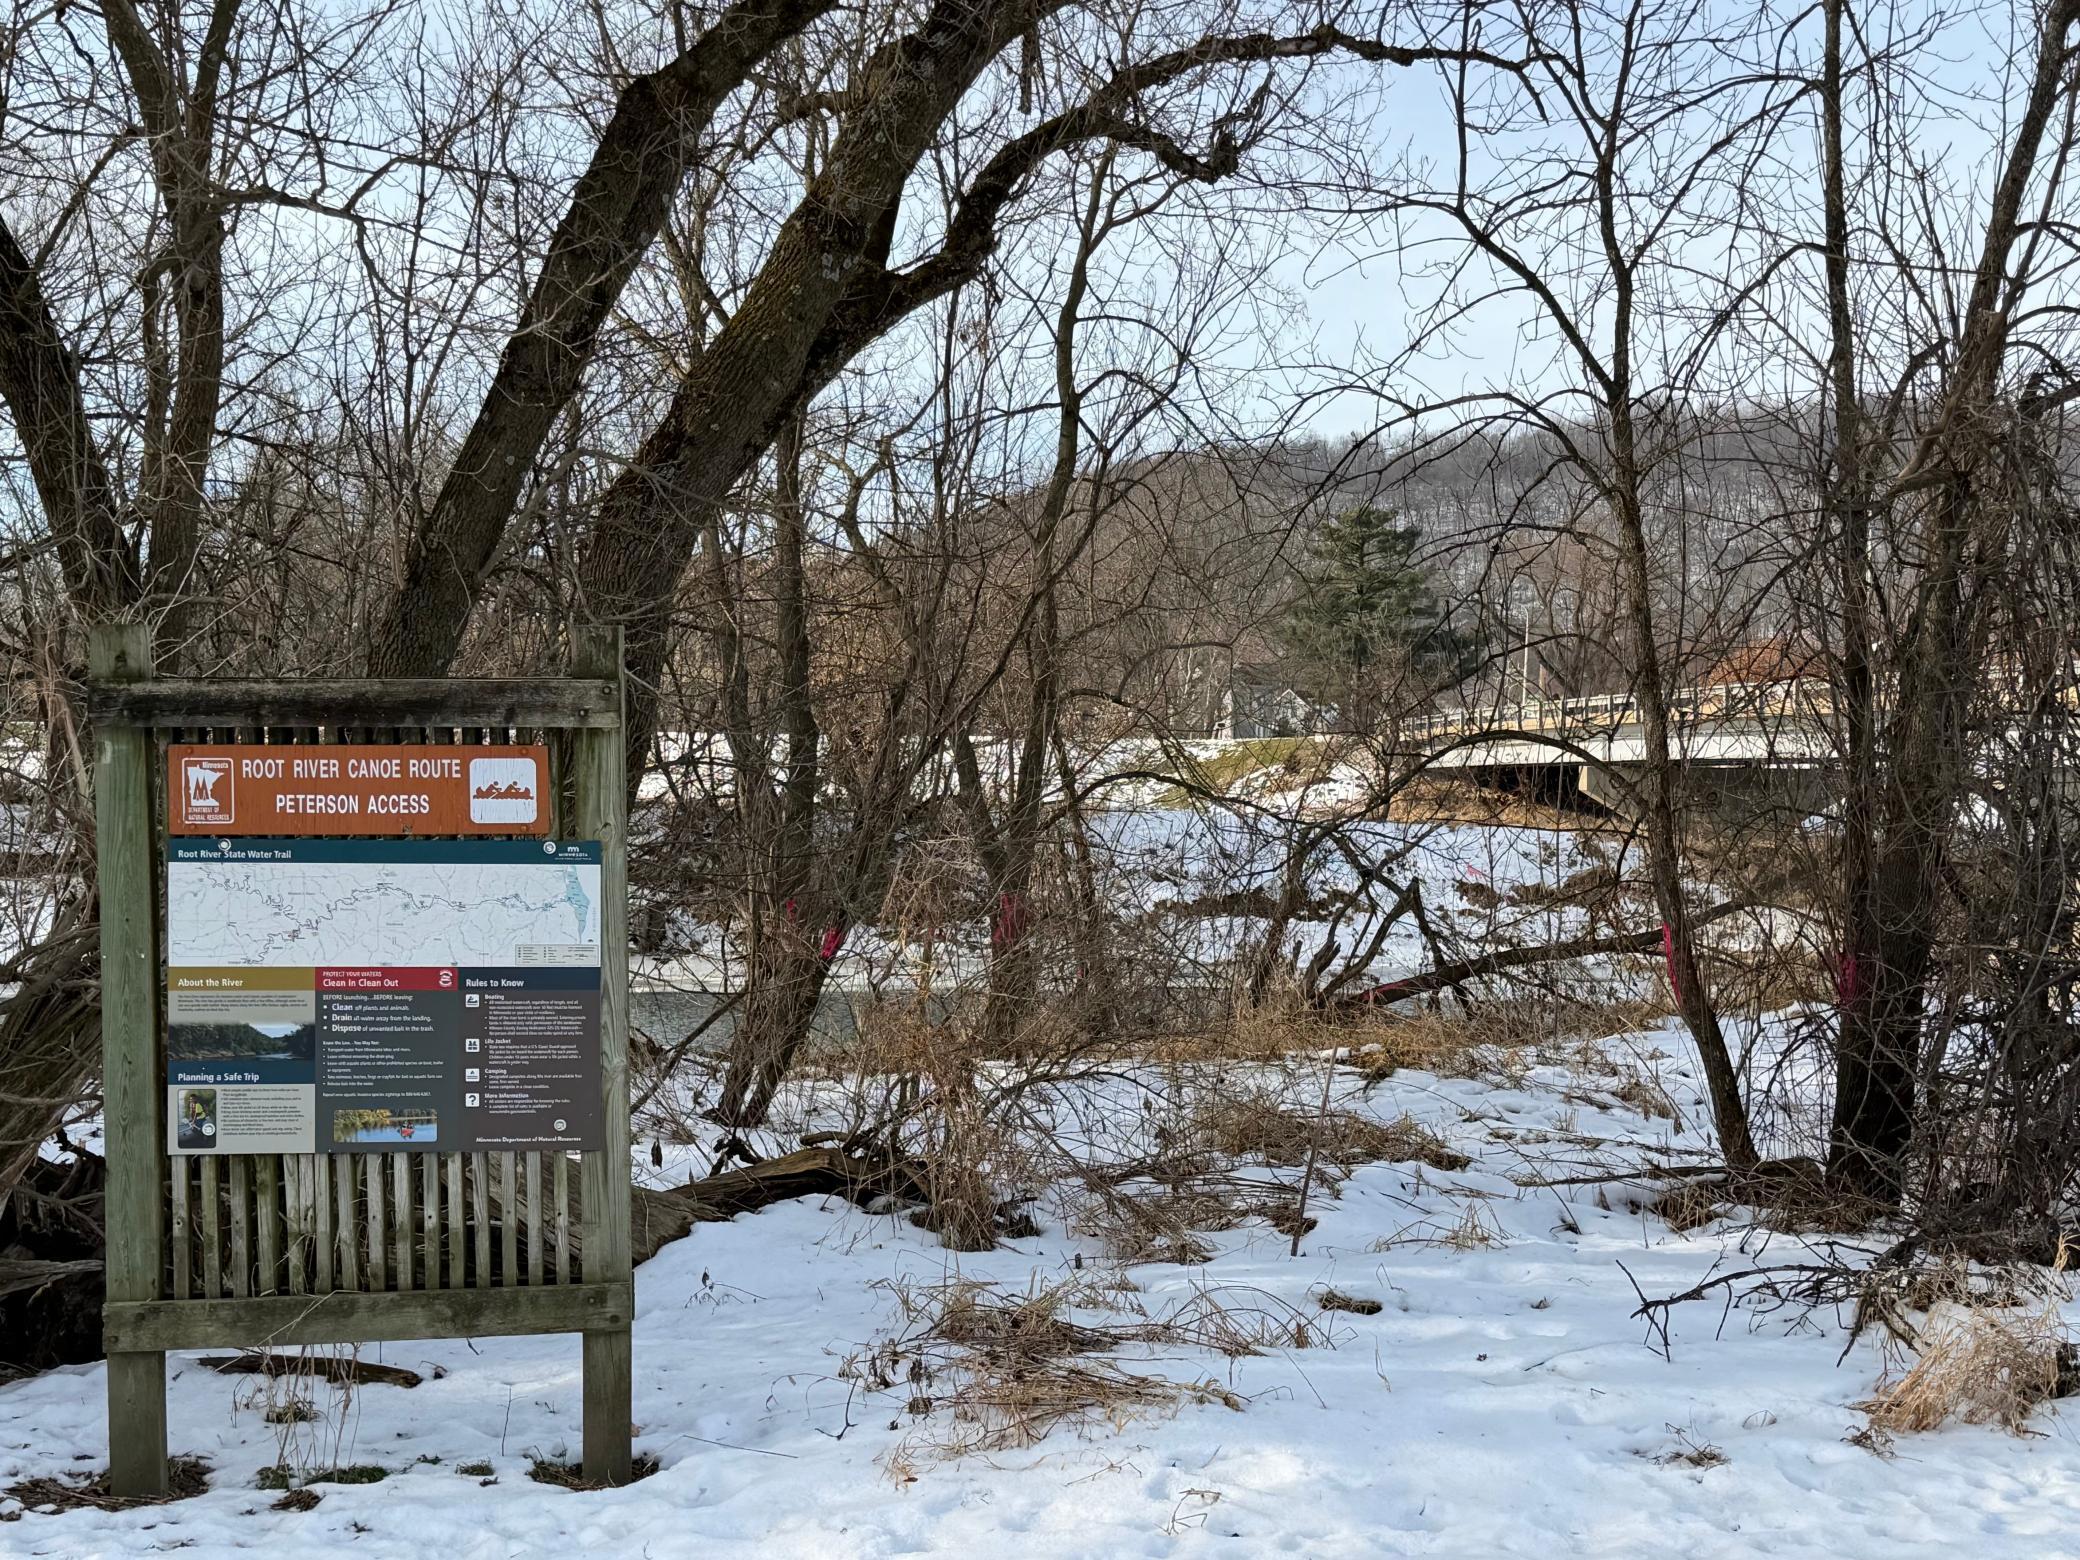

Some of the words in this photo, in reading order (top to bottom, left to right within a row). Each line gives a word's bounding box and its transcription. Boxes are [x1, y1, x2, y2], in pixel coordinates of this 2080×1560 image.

[242, 760, 284, 778] ROOT
[293, 760, 340, 778] RIVER
[348, 760, 402, 778] CANOE
[410, 760, 461, 778] ROUTE
[276, 794, 359, 814] PETERSON
[368, 794, 430, 814] ACCESS
[178, 850, 198, 858] Root
[200, 850, 221, 858] River
[224, 850, 245, 858] State
[248, 850, 272, 858] Water
[274, 850, 291, 858] Trail
[178, 978, 204, 987] About
[206, 978, 220, 987] the
[222, 978, 243, 987] River
[323, 978, 346, 987] Clean
[348, 978, 356, 987] In
[358, 978, 381, 987] Clean
[384, 978, 399, 987] Out
[465, 979, 487, 987] Rules
[490, 979, 498, 987] to
[501, 979, 524, 987] Know
[332, 1024, 362, 1032] Dispose
[178, 1072, 214, 1083] Planning
[224, 1072, 242, 1081] Safe
[244, 1072, 260, 1082] Trip
